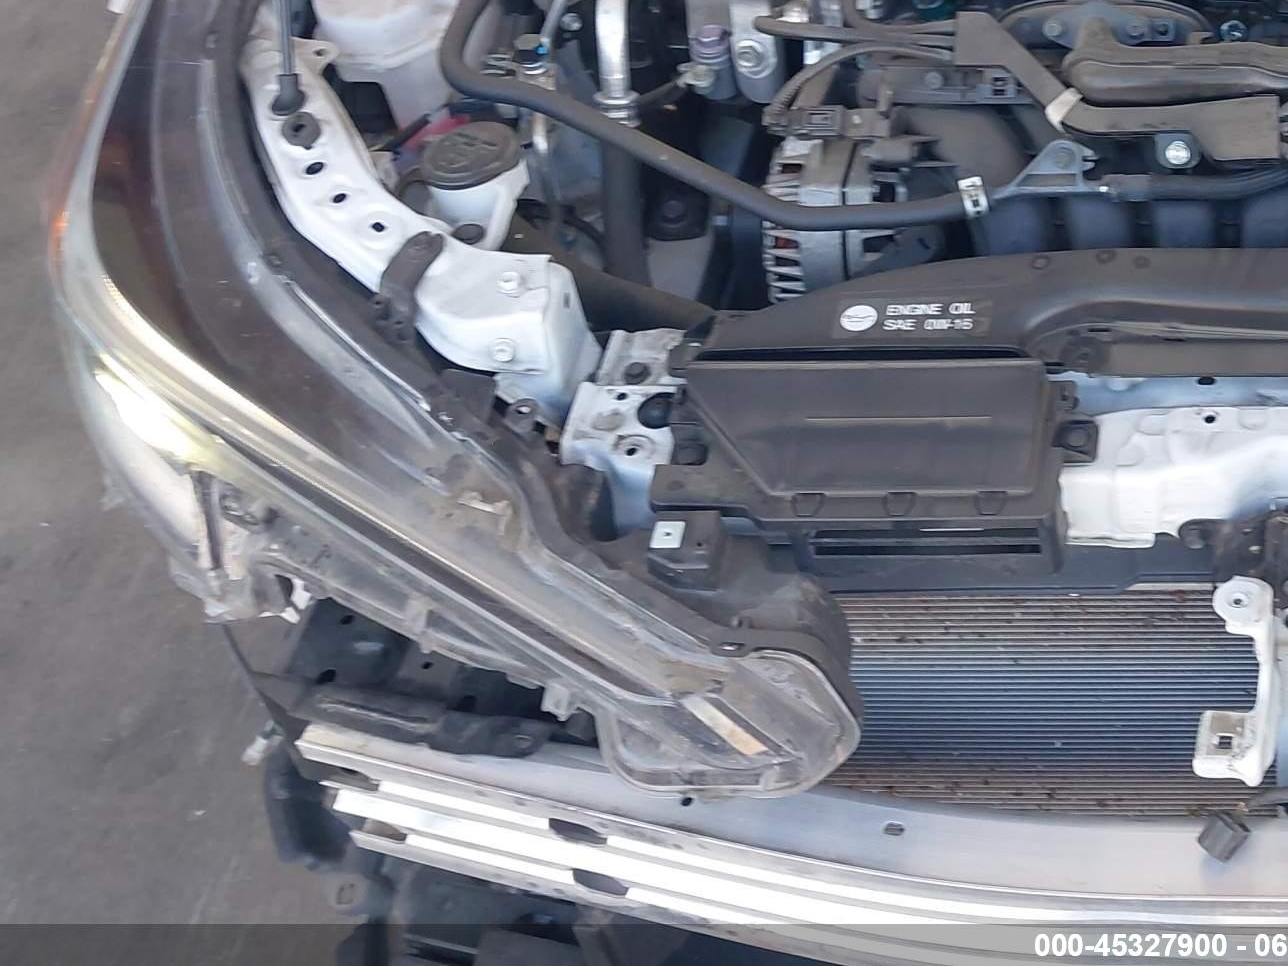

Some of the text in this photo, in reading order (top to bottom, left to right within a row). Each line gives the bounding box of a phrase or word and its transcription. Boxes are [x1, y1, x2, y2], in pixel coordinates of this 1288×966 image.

[886, 302, 977, 316] ENGINE OIL
[882, 318, 917, 331] SAE
